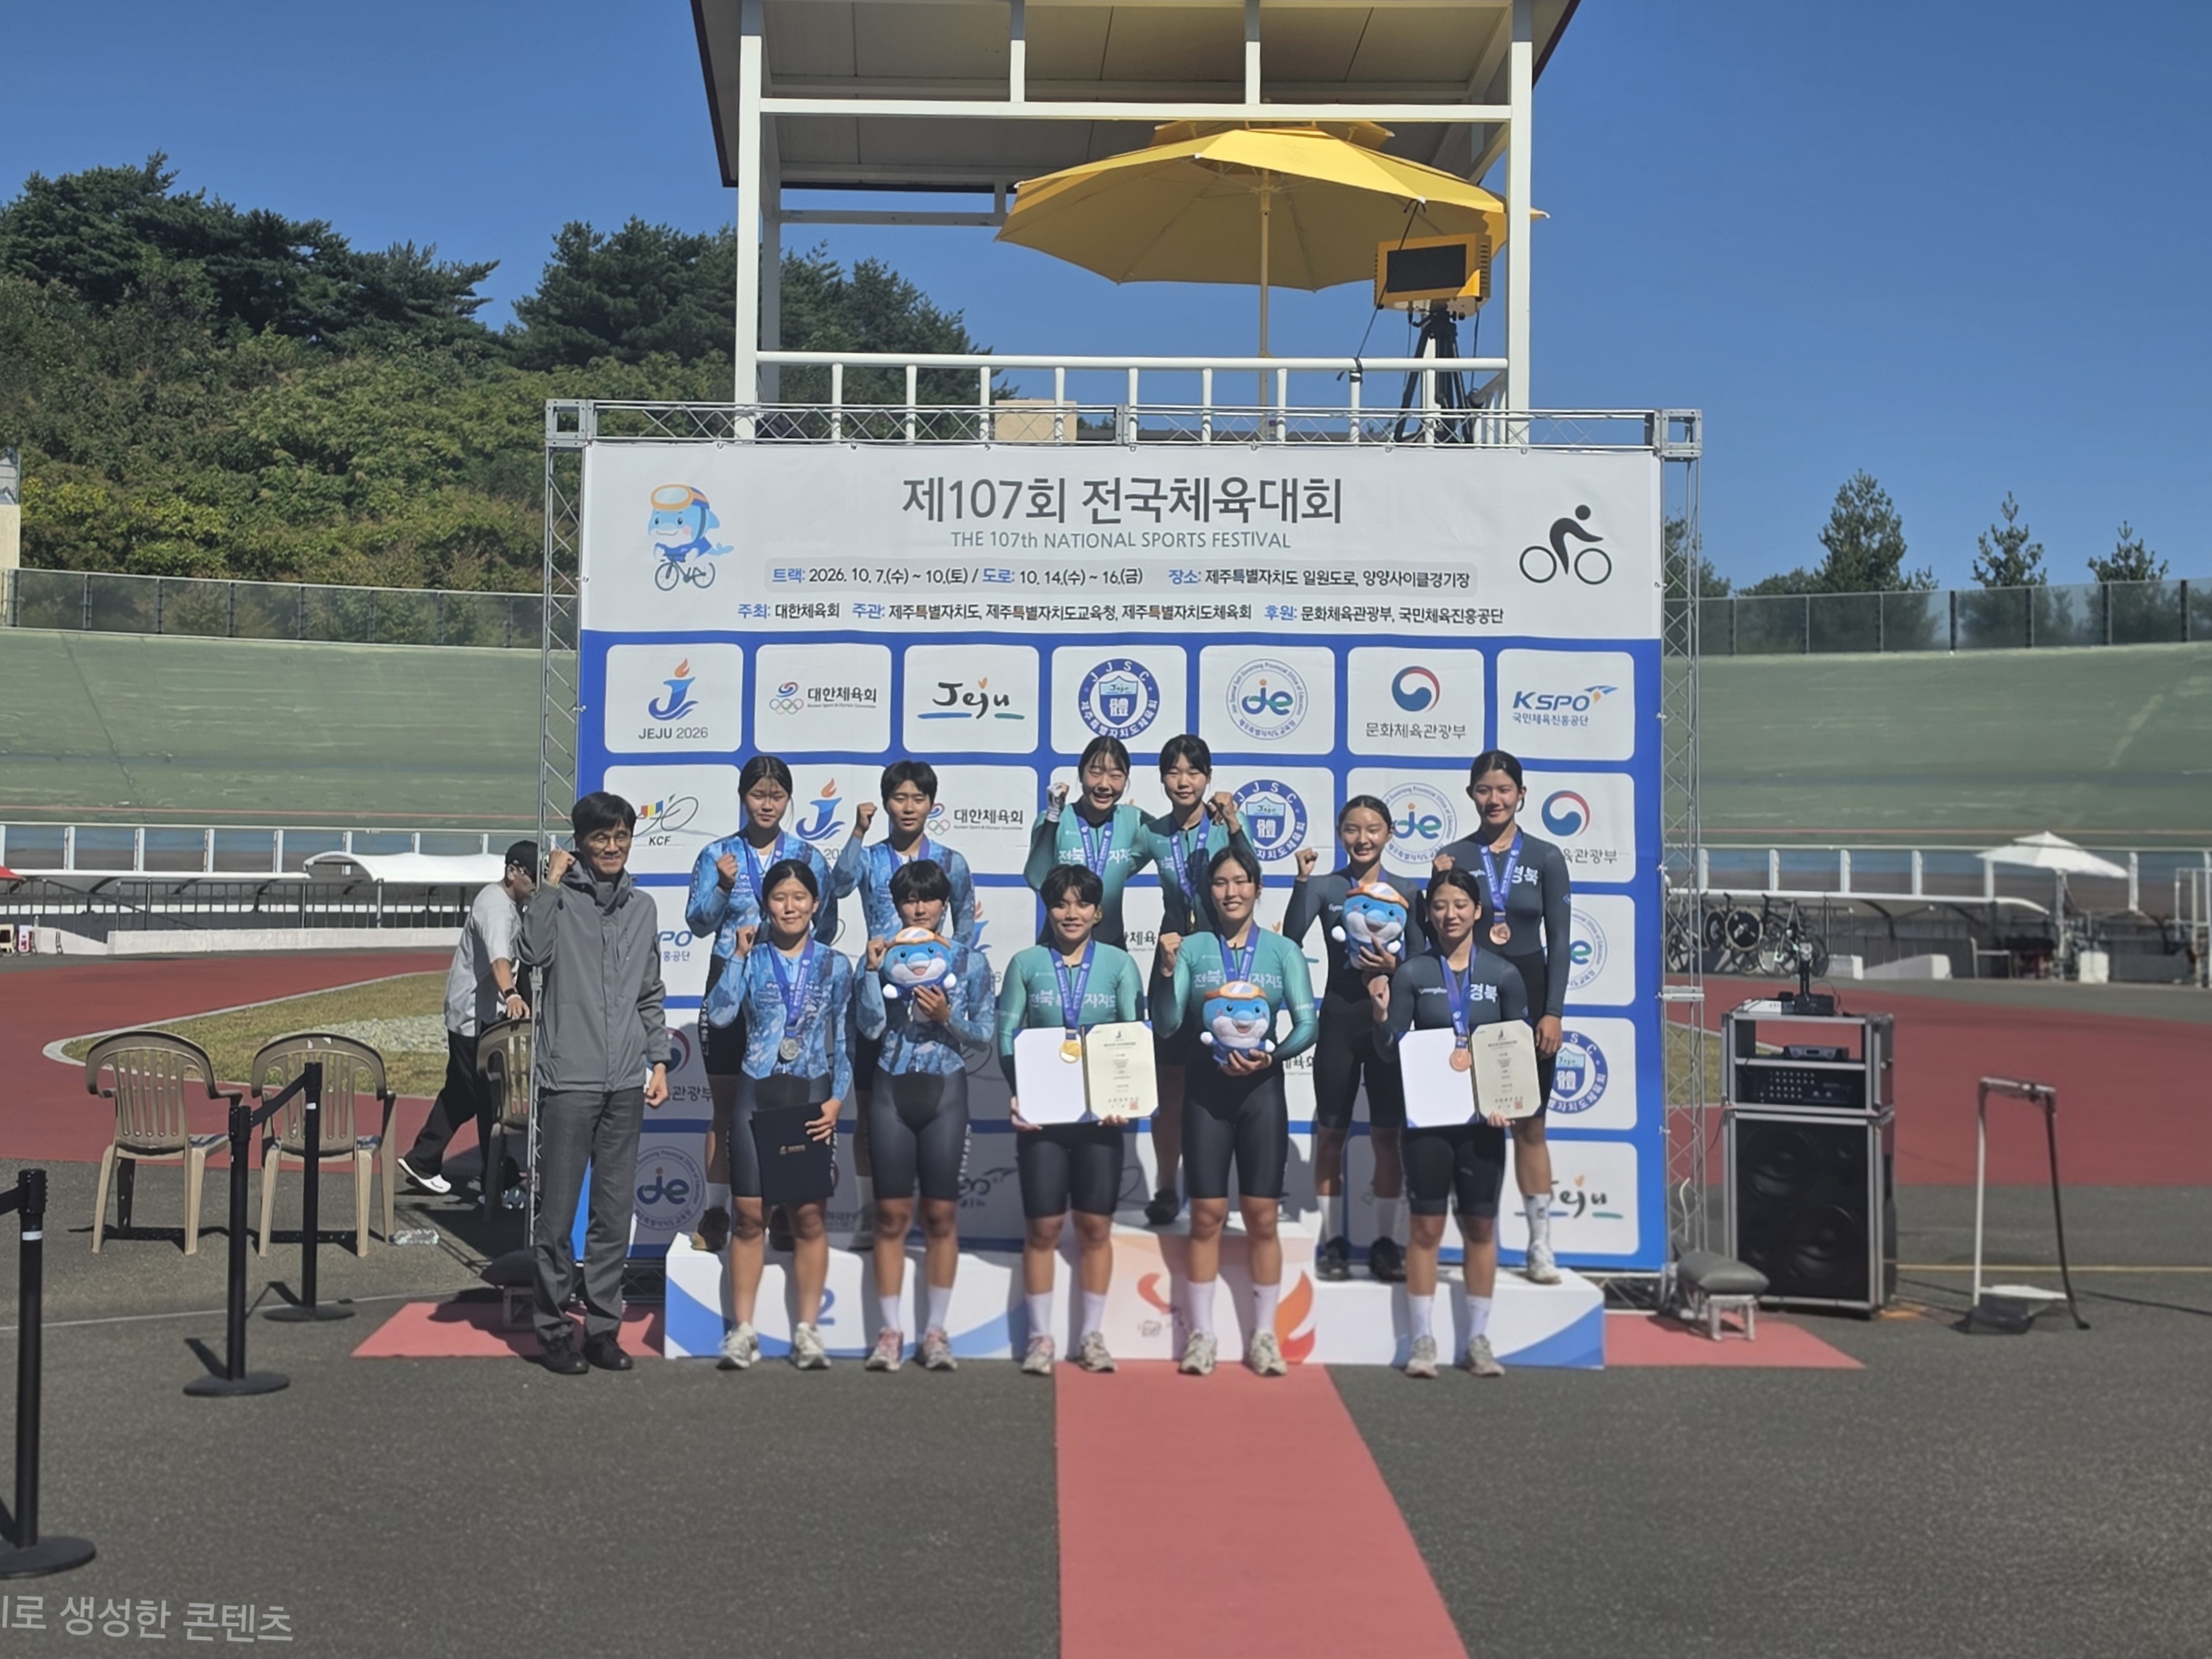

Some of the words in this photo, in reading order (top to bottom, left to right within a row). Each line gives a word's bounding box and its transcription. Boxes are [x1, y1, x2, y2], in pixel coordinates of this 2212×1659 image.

[902, 477, 1065, 523] 제107회
[1082, 477, 1341, 524] 전국체육대회
[951, 531, 983, 546] THE
[991, 531, 1037, 547] 107th
[1044, 532, 1136, 548] NATIONAL
[1142, 532, 1206, 547] SPORTS
[1213, 531, 1291, 548] FESTIVAL
[772, 568, 805, 583] 트랙:
[809, 568, 847, 582] 2026.
[852, 568, 872, 583] 10.
[876, 568, 909, 585] 7.(수)
[926, 568, 968, 584] 10.(토)
[982, 568, 1015, 583] 도로:
[1020, 571, 1040, 585] 10.
[1044, 569, 1085, 586] 14.(수)
[1103, 568, 1143, 585] 16.(금)
[1169, 569, 1201, 584] 장소:
[1205, 569, 1299, 585] 제주특별자치도
[1303, 570, 1358, 587] 일원도로,
[738, 604, 770, 619] 주최:
[775, 603, 839, 619] 대한체육회
[853, 603, 885, 619] 주관:
[888, 604, 982, 620] 제주특별자치도,
[985, 604, 1118, 621] 제주특별자치도교육청,
[1122, 604, 1251, 620] 제주특별자치도체육회
[1265, 605, 1297, 620] 후원:
[1301, 606, 1395, 623] 문화체육관광부,
[1399, 607, 1504, 625] 국민체육진흥공단
[932, 677, 1011, 719] Jeju
[1512, 690, 1591, 713] KSPO
[639, 728, 672, 739] JEJU
[676, 727, 708, 739] 2026
[1366, 723, 1465, 739] 문화체육관광부
[648, 835, 671, 846] KCF
[1470, 983, 1498, 1003] 경북
